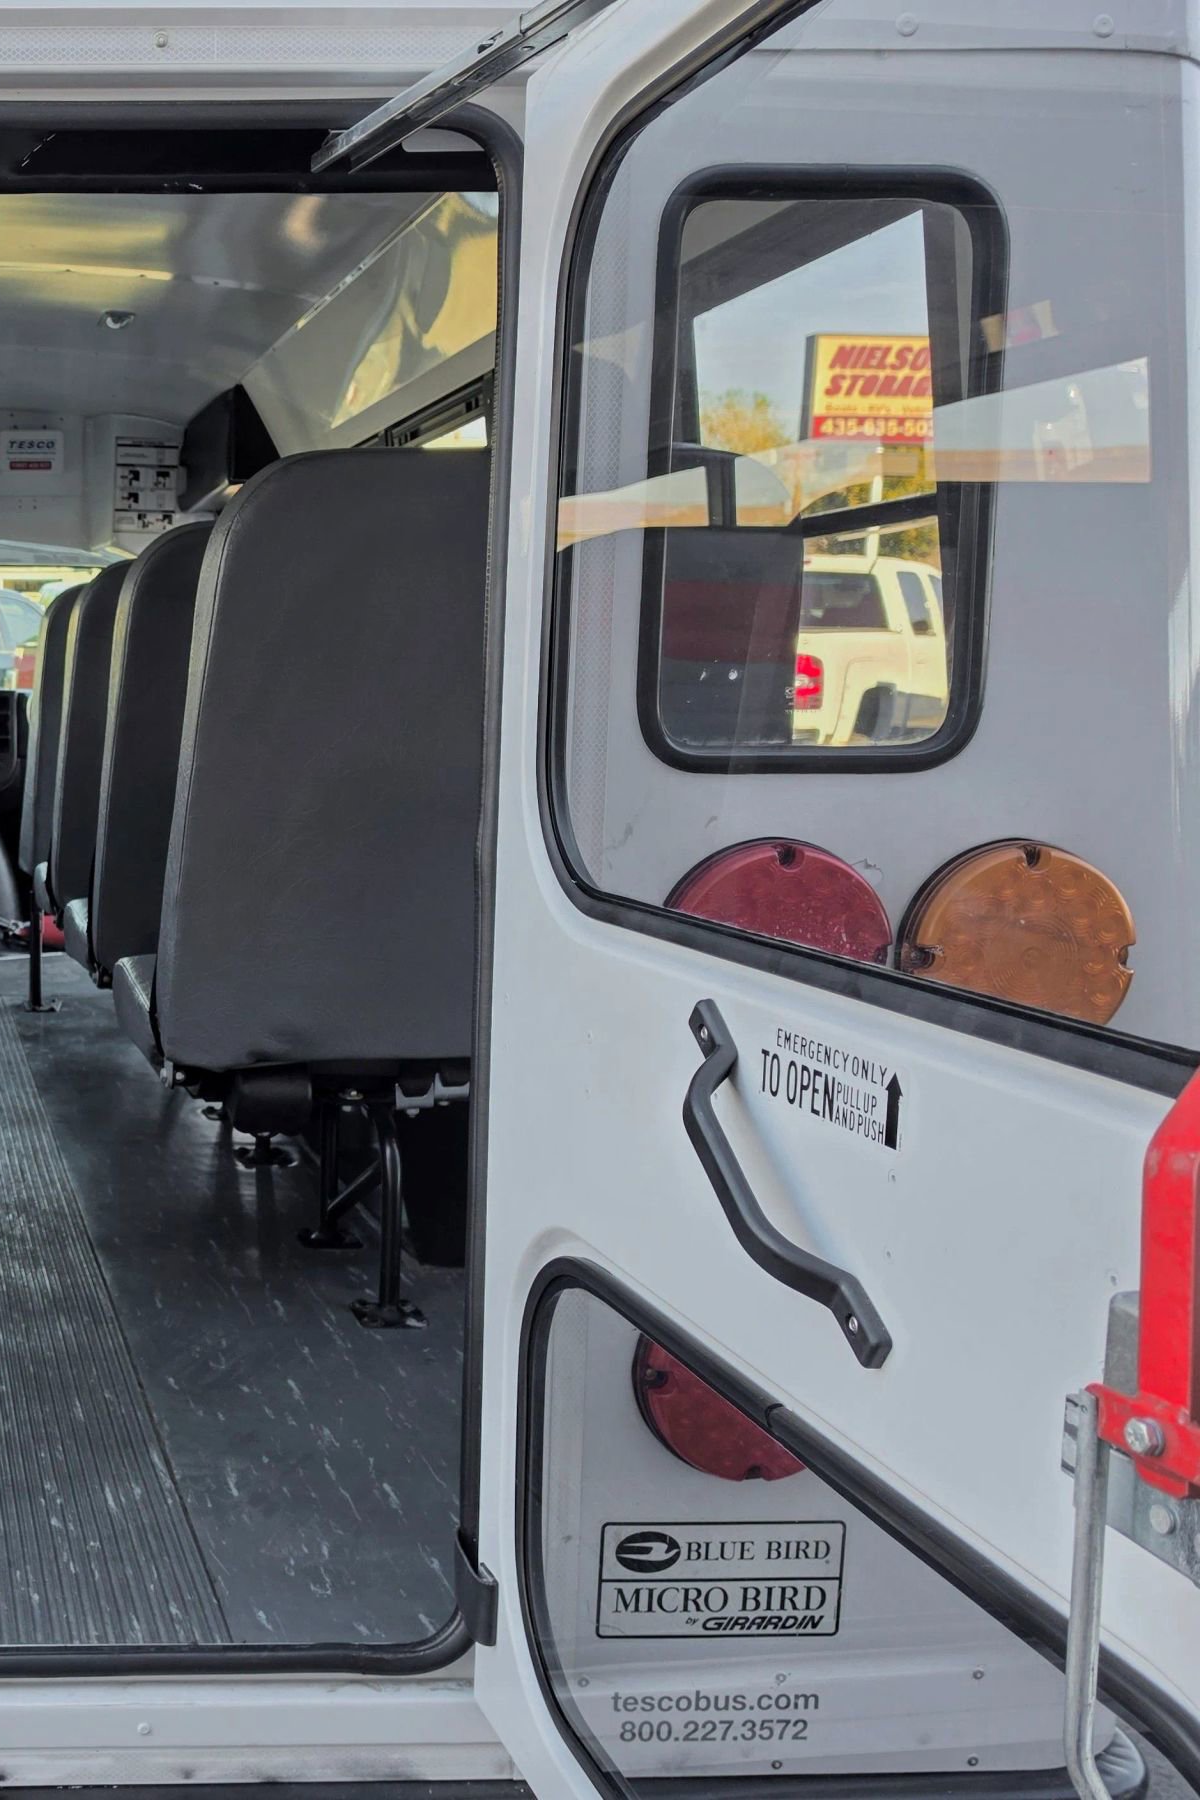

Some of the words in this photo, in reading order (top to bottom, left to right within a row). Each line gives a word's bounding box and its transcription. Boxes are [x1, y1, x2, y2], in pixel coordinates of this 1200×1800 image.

[9, 440, 55, 449] TESCO
[776, 1028, 850, 1073] EMERGENCY
[851, 1056, 888, 1087] ONLY
[761, 1048, 781, 1097] TO
[786, 1060, 836, 1122] OPEN
[836, 1082, 861, 1111] PULL
[863, 1092, 877, 1116] UP
[834, 1105, 855, 1131] AND
[857, 1113, 885, 1145] PUSH
[684, 1541, 755, 1561] BLUE
[766, 1540, 831, 1560] BIRD
[612, 1586, 729, 1614] MICRO
[738, 1585, 827, 1612] BIRD
[685, 1617, 699, 1626] by
[702, 1615, 825, 1631] GIRARDIN
[611, 1690, 820, 1713] tescobus.com
[619, 1719, 809, 1742] 800.227.3572
